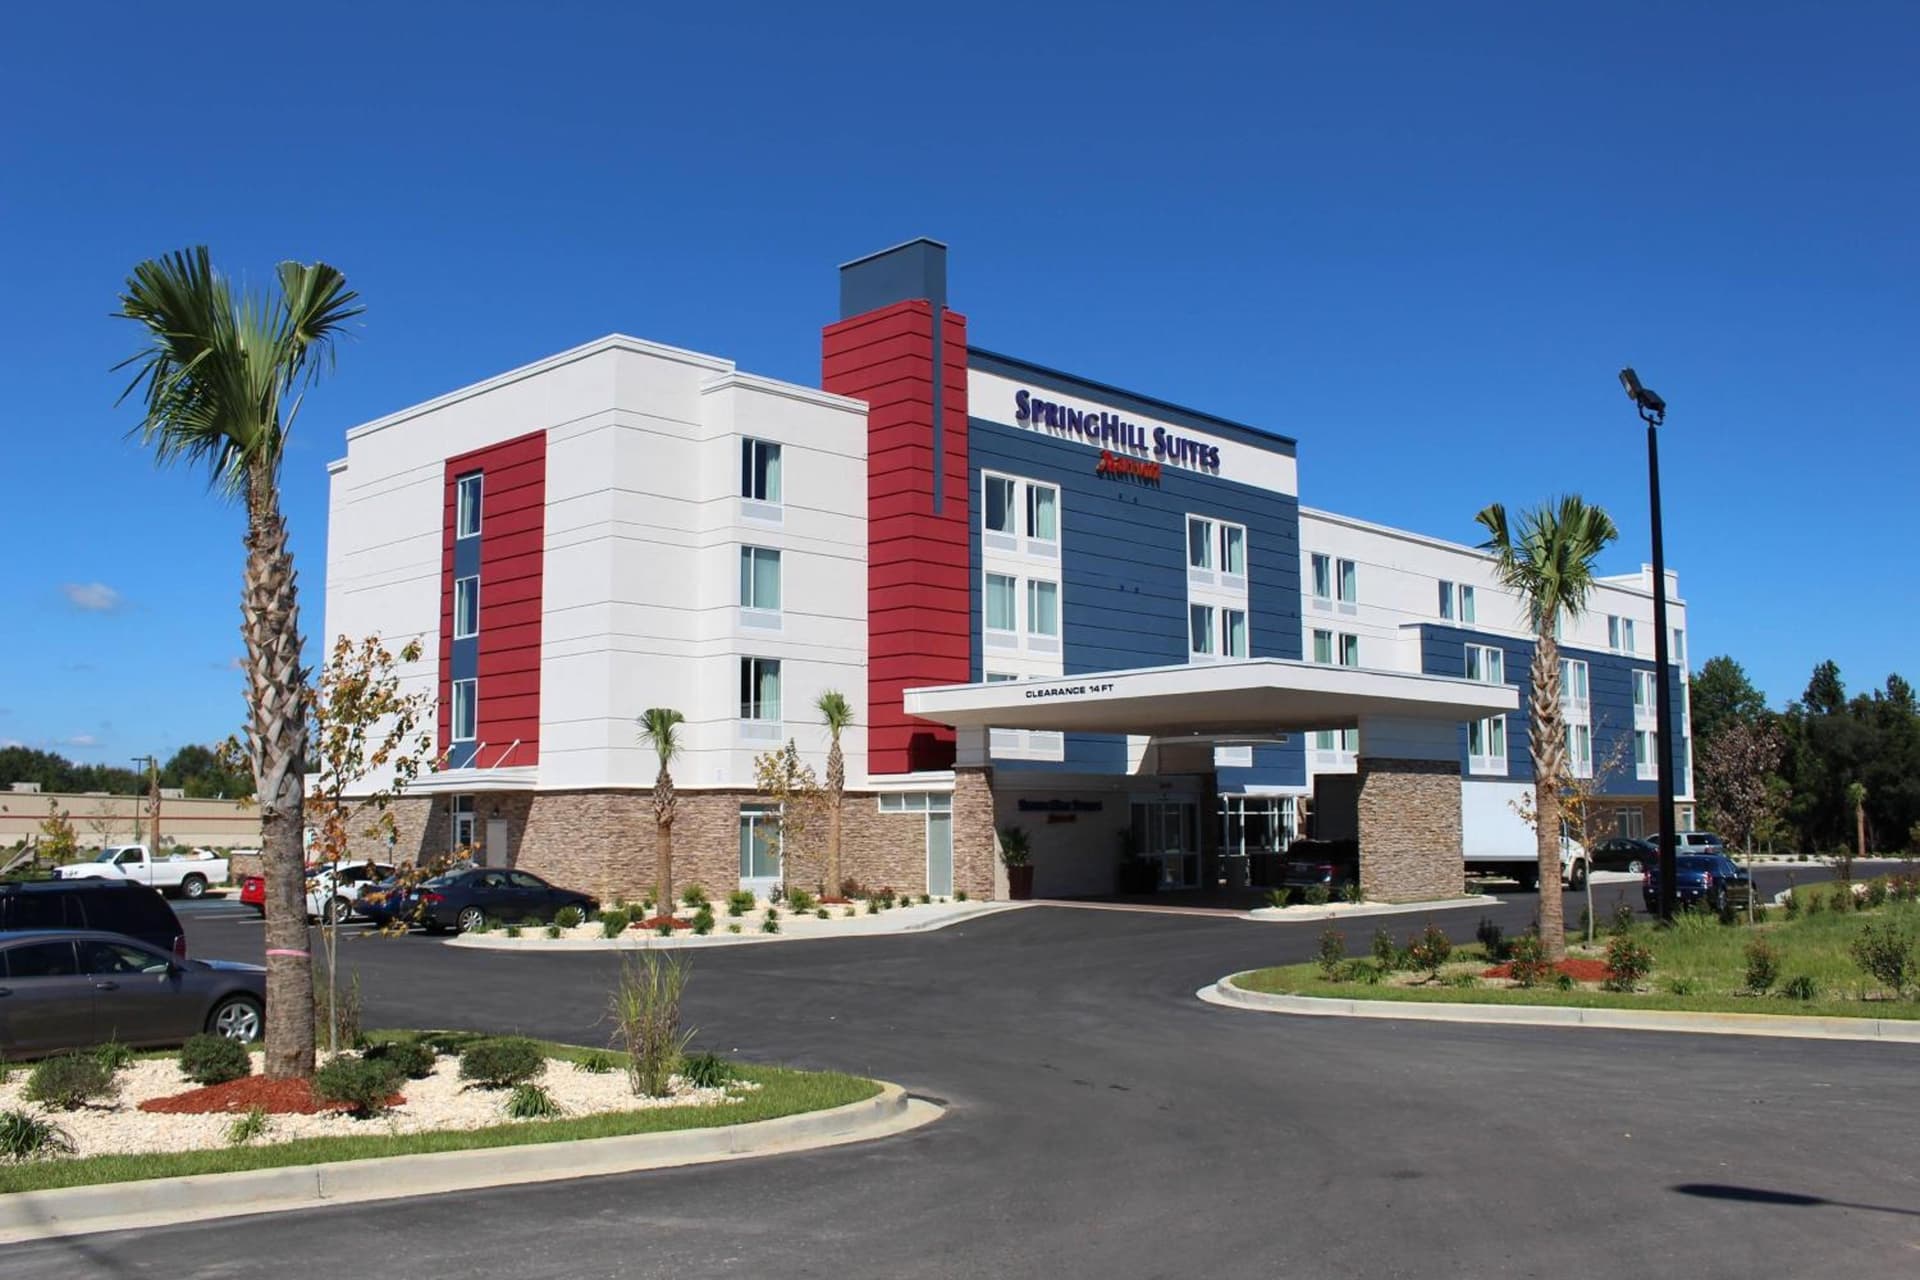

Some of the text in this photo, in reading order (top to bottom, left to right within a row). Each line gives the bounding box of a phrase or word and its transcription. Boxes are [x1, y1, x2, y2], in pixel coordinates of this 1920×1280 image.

[1153, 427, 1220, 469] SUITES
[1025, 684, 1114, 698] CLEARANCE 14 FT
